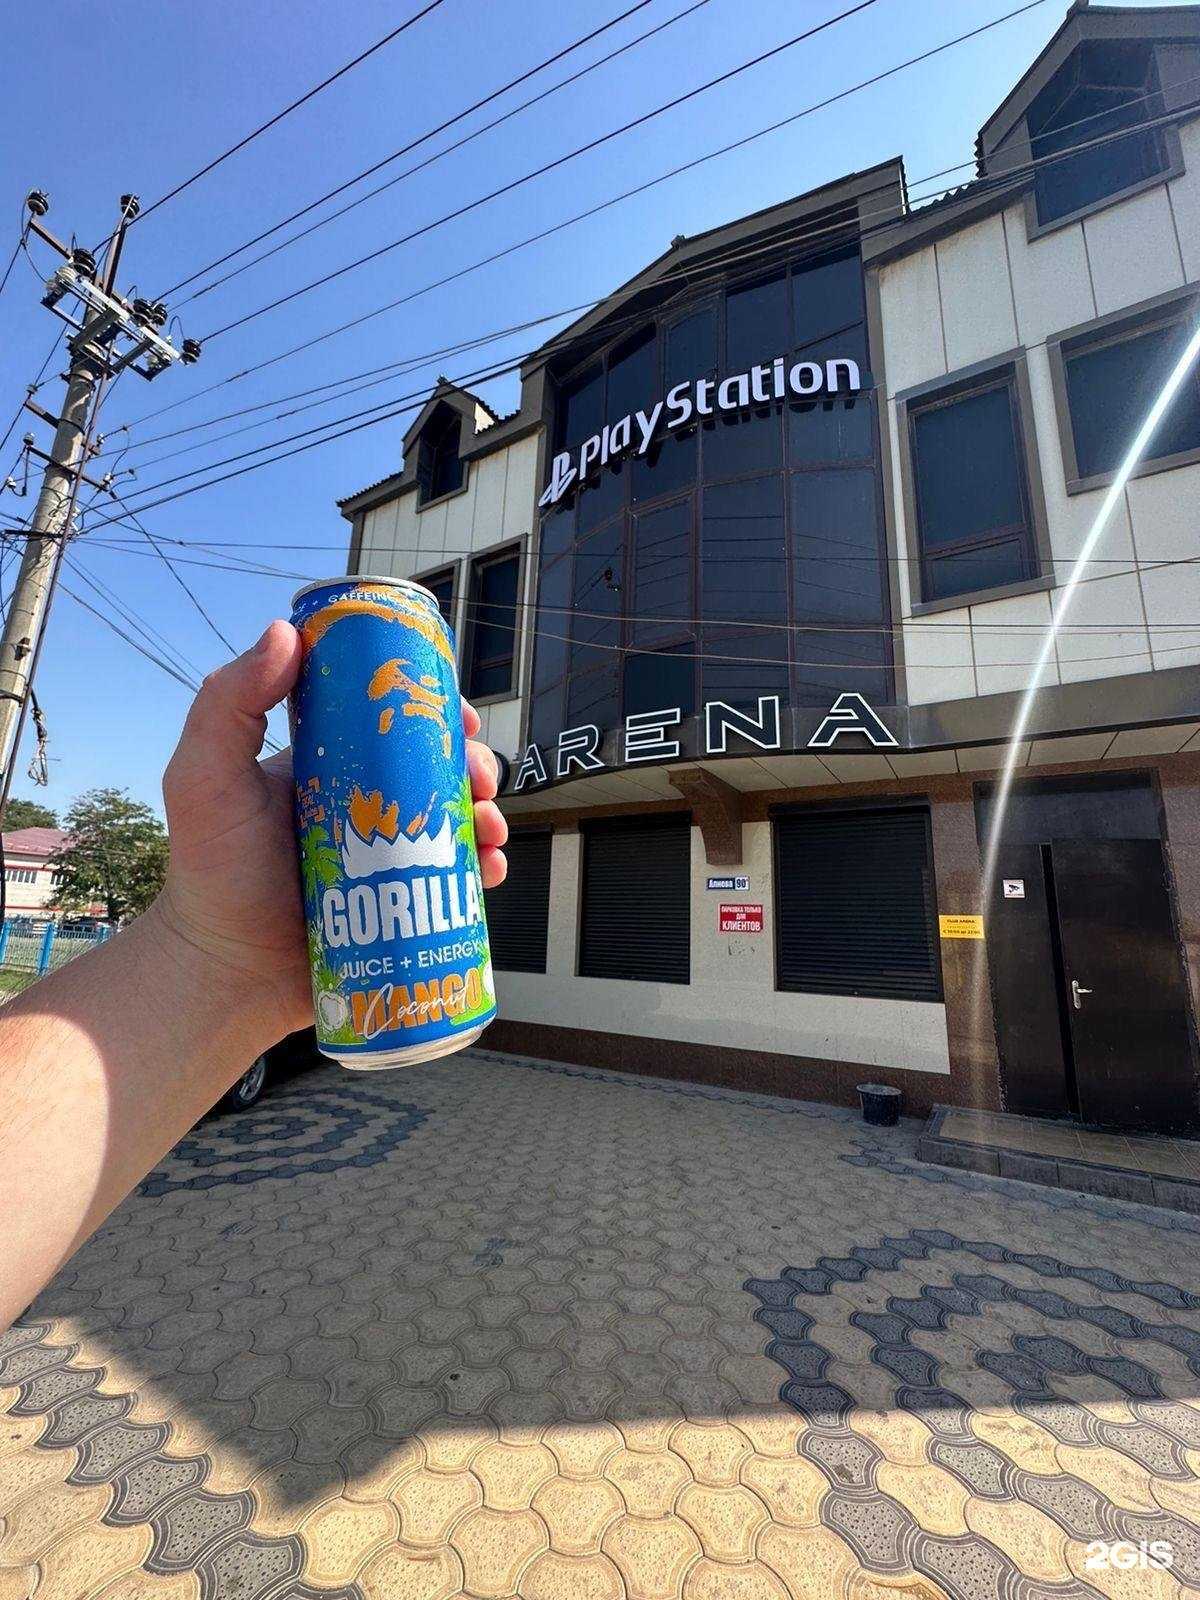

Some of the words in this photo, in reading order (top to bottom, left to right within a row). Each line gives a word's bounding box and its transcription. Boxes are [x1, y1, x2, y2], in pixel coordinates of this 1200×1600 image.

[578, 357, 862, 481] PlayStation
[514, 692, 900, 791] ARENA
[322, 871, 481, 949] GORILLA
[722, 920, 761, 931] КЛИЕНТОВ
[340, 955, 395, 980] JUICE
[417, 940, 480, 968] ENERGY
[351, 967, 483, 1037] MANGO
